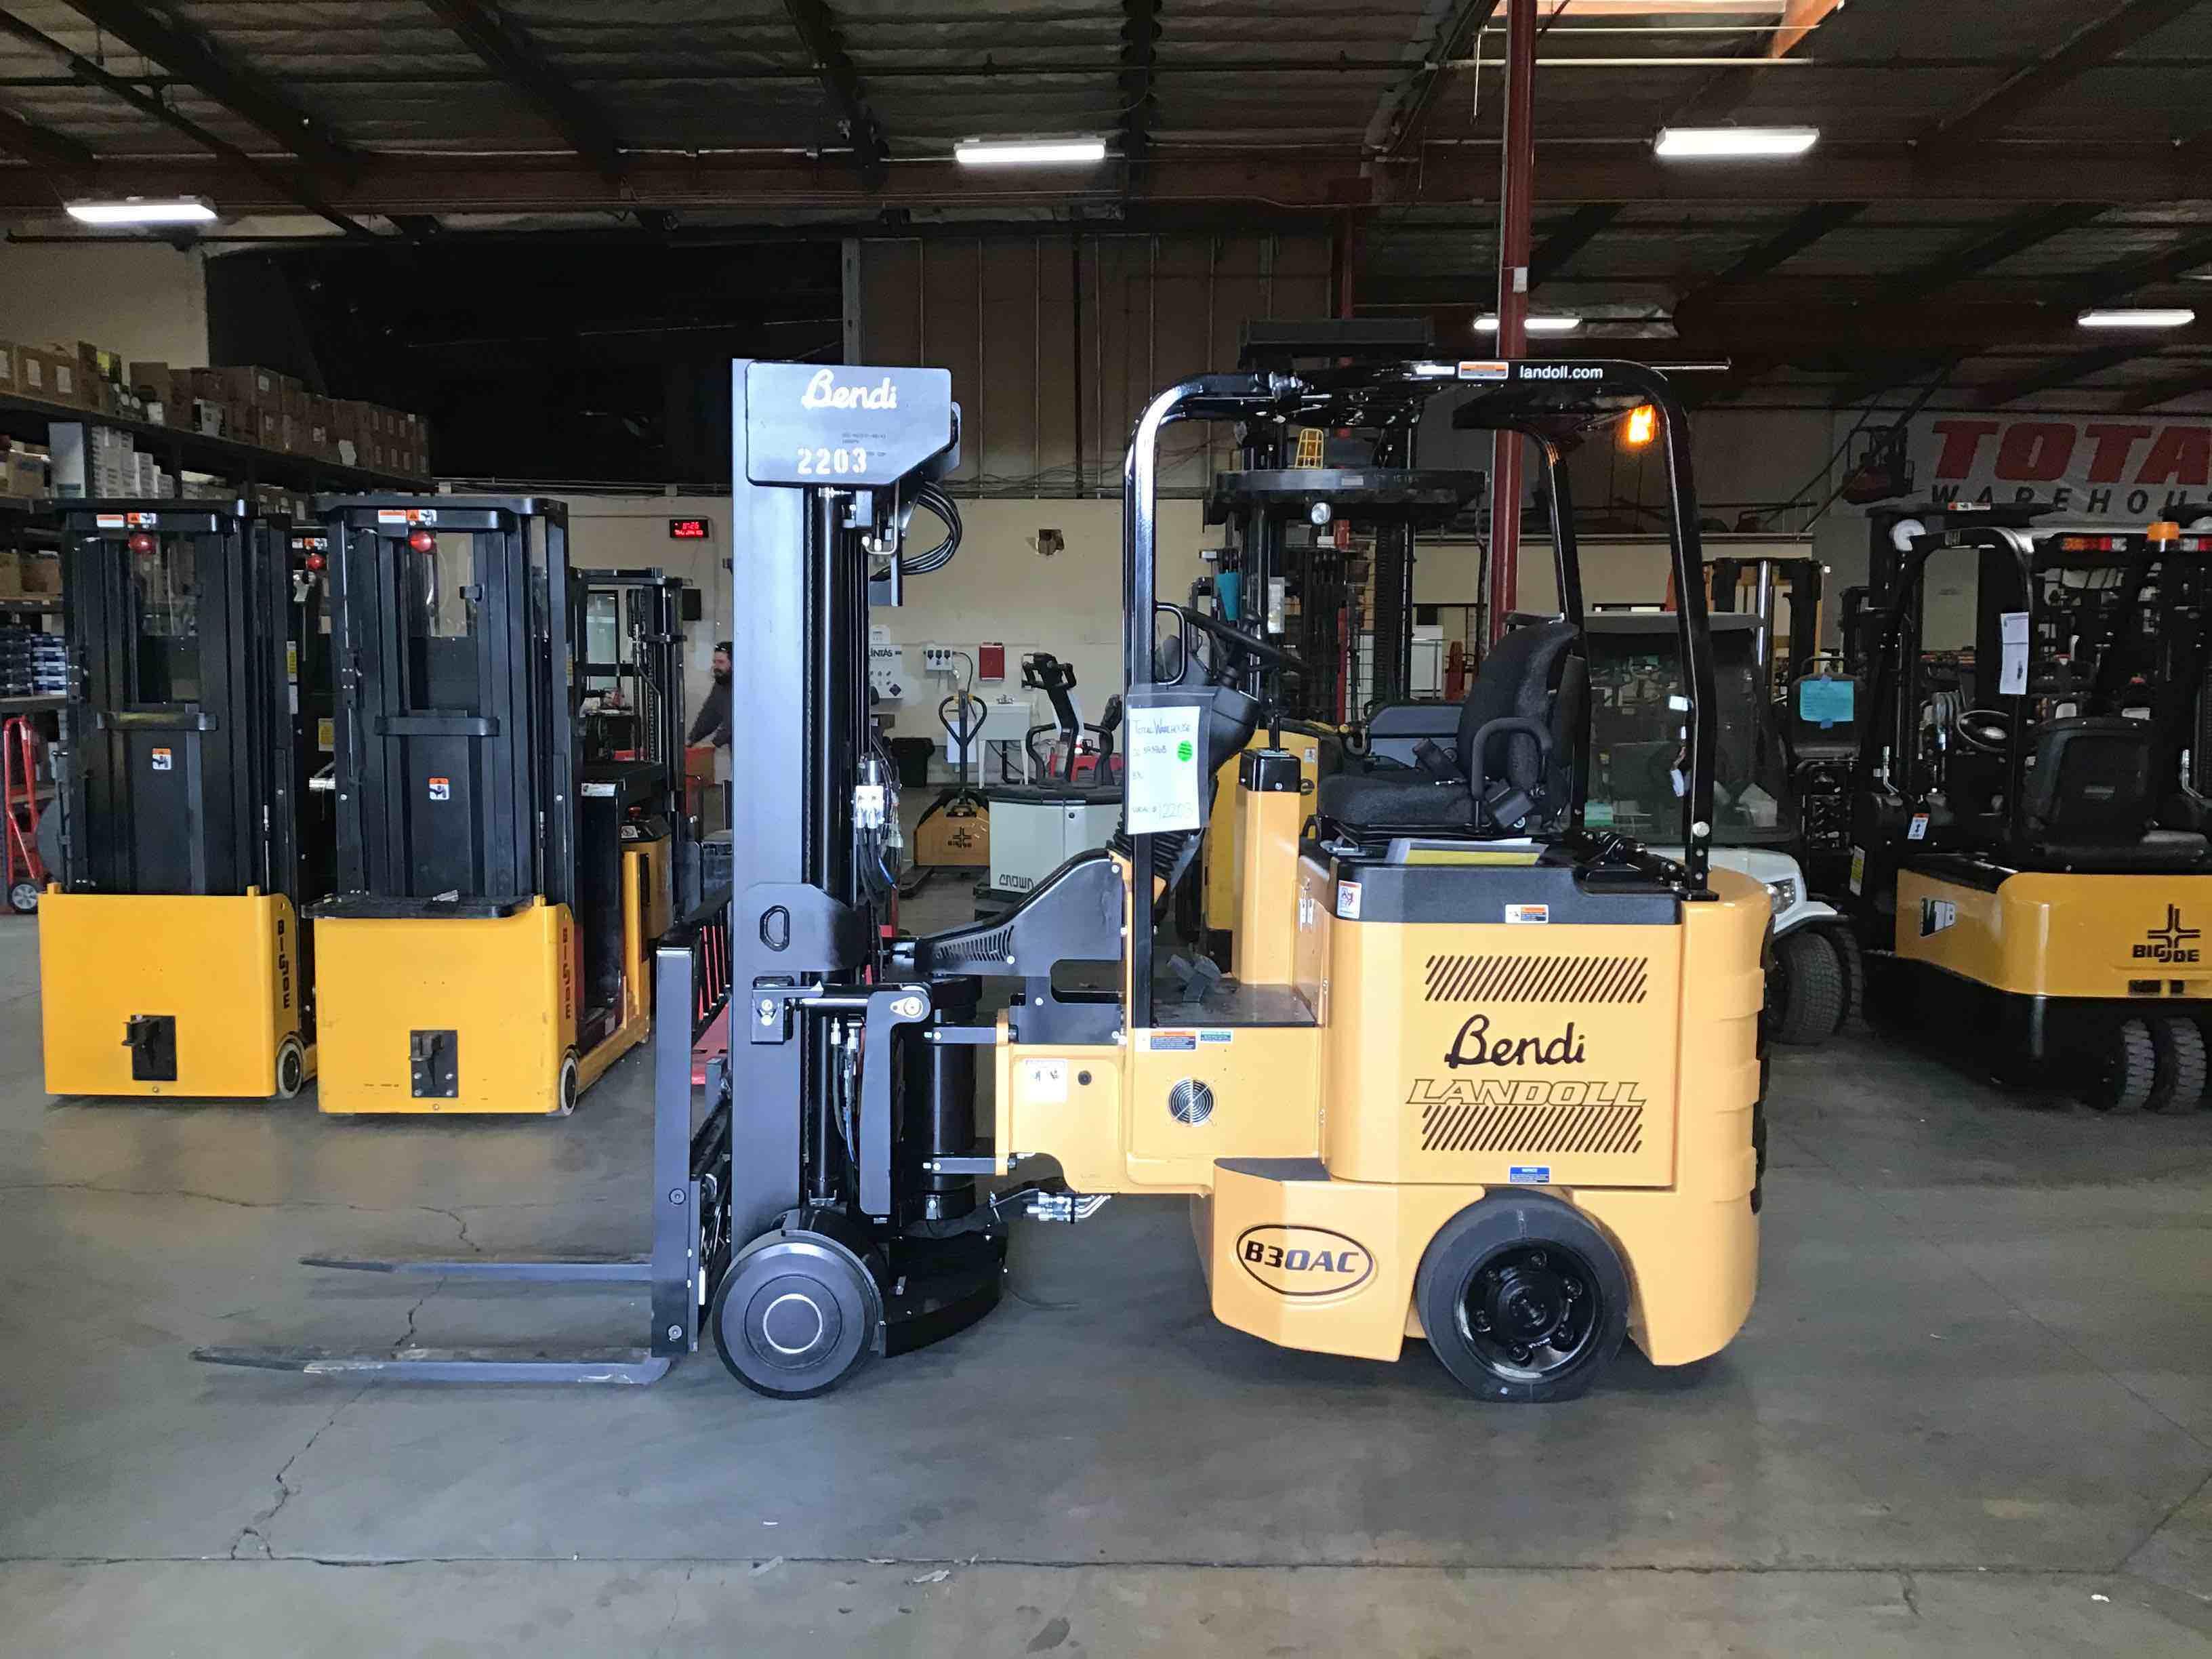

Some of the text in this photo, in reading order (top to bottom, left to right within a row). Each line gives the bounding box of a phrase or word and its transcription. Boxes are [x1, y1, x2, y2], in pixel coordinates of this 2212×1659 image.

[1519, 365, 1603, 381] landoll.com
[802, 368, 898, 409] Bendi
[797, 447, 867, 476] 2203
[1931, 485, 2212, 514] WAREHOU
[869, 648, 893, 657] INTAS
[1444, 1013, 1586, 1069] Bendi
[1406, 1078, 1647, 1108] LANDOLL
[1244, 1240, 1359, 1273] B30AC
